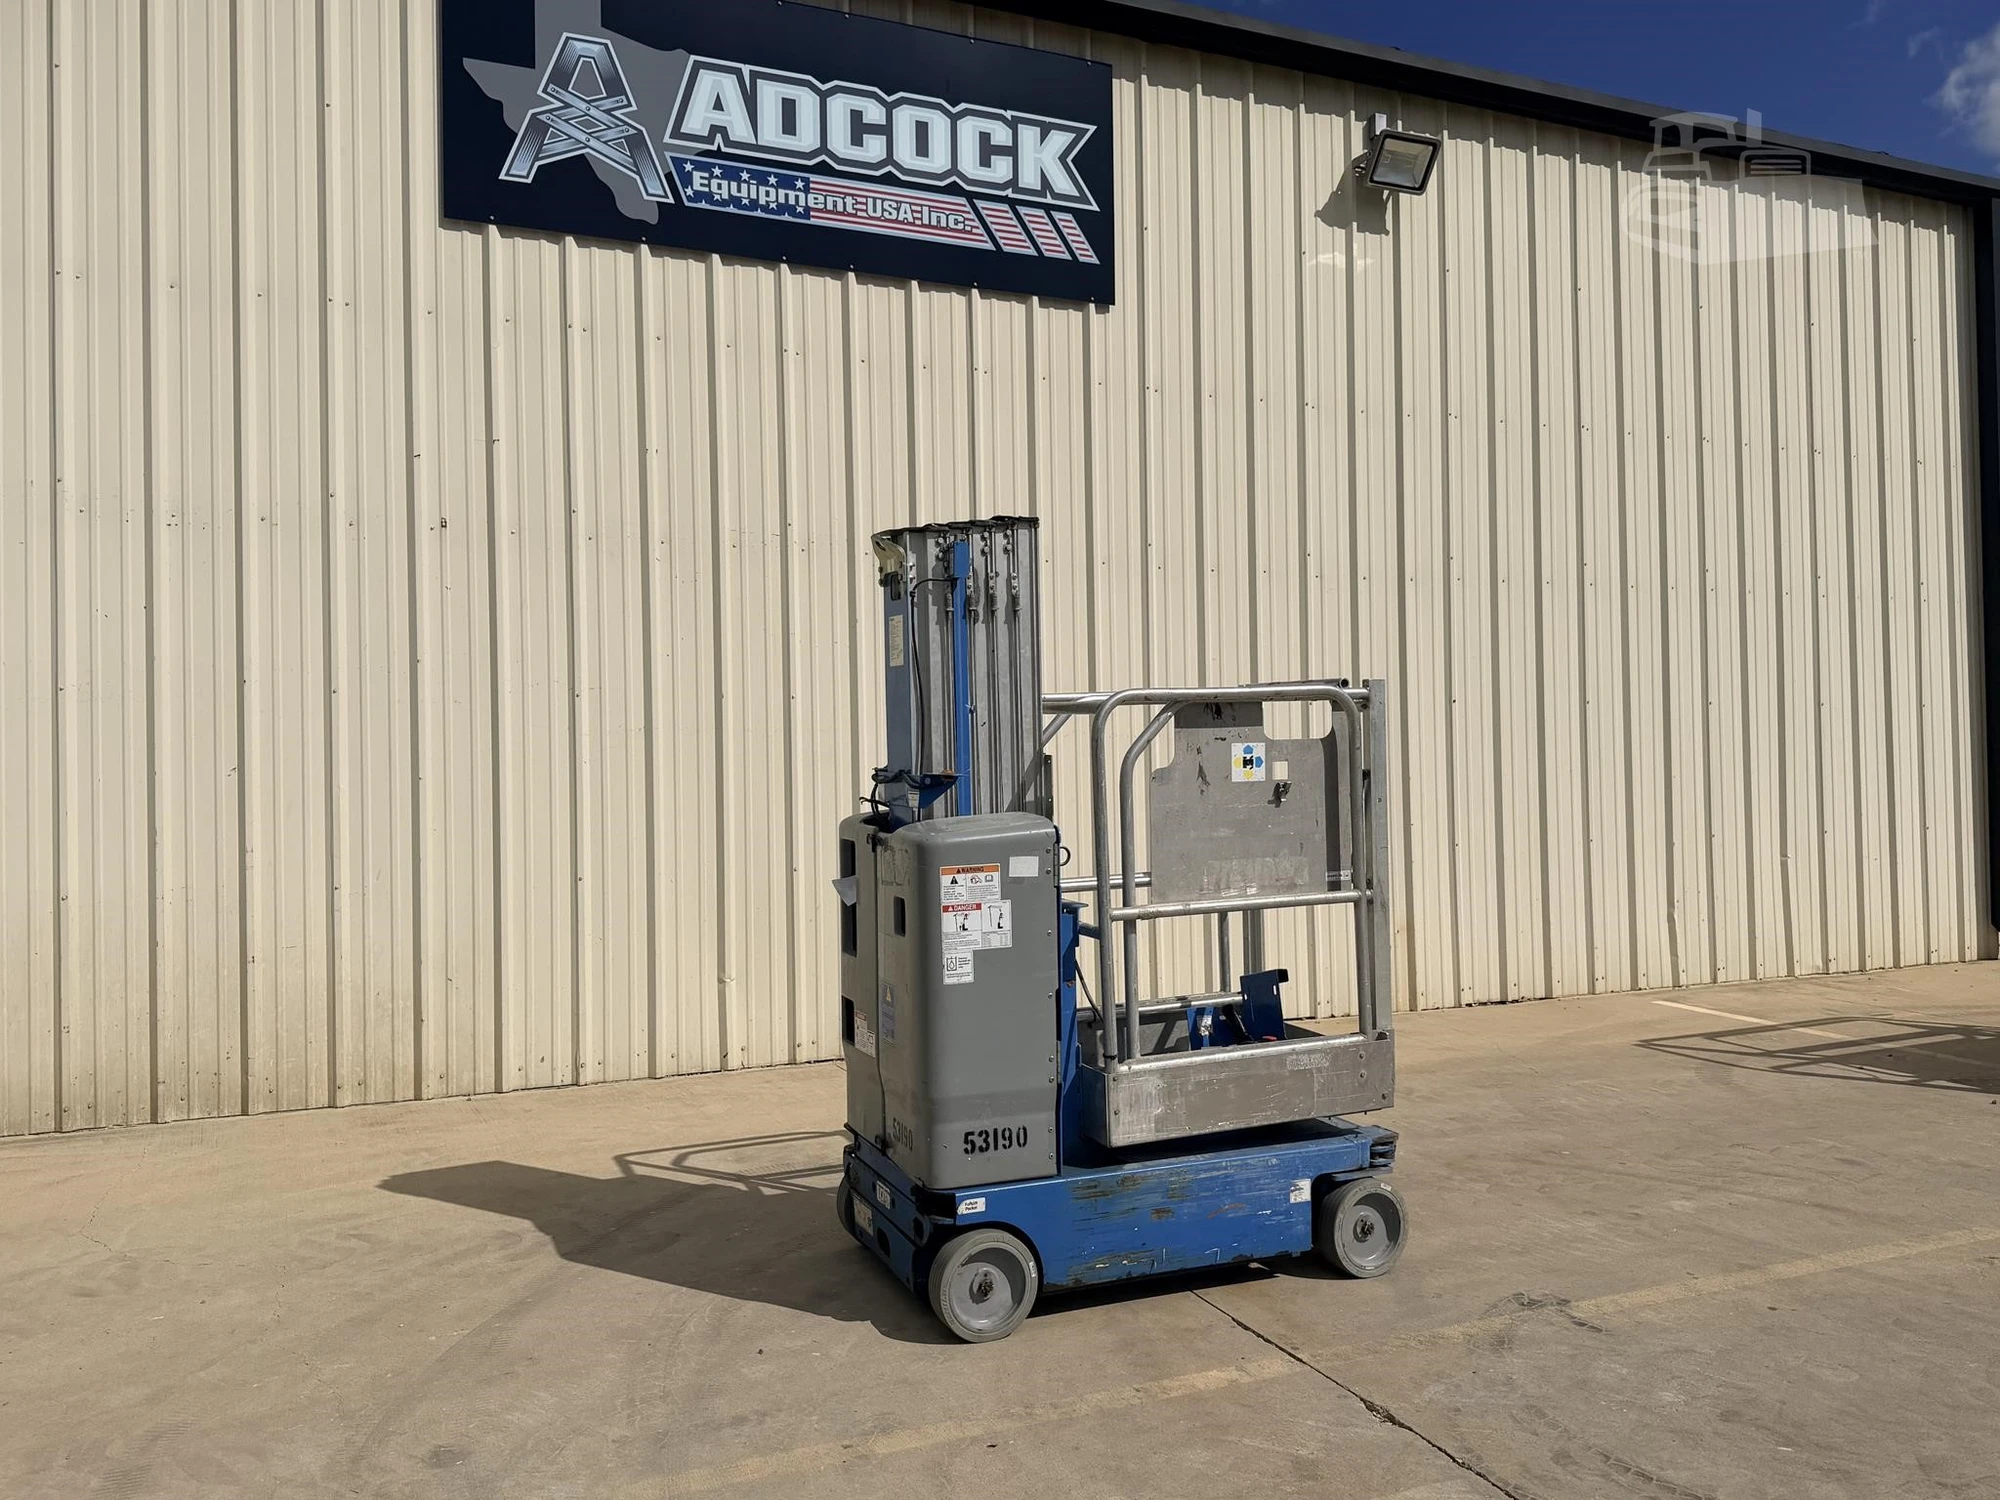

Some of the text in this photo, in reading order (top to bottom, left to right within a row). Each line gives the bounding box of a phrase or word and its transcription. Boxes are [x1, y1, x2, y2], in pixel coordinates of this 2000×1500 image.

[674, 65, 1086, 199] ADCOCK
[691, 169, 973, 232] Equipment USA Inc.
[961, 866, 985, 874] WARNING
[953, 903, 977, 911] DANGER
[963, 1125, 1028, 1155] 53190
